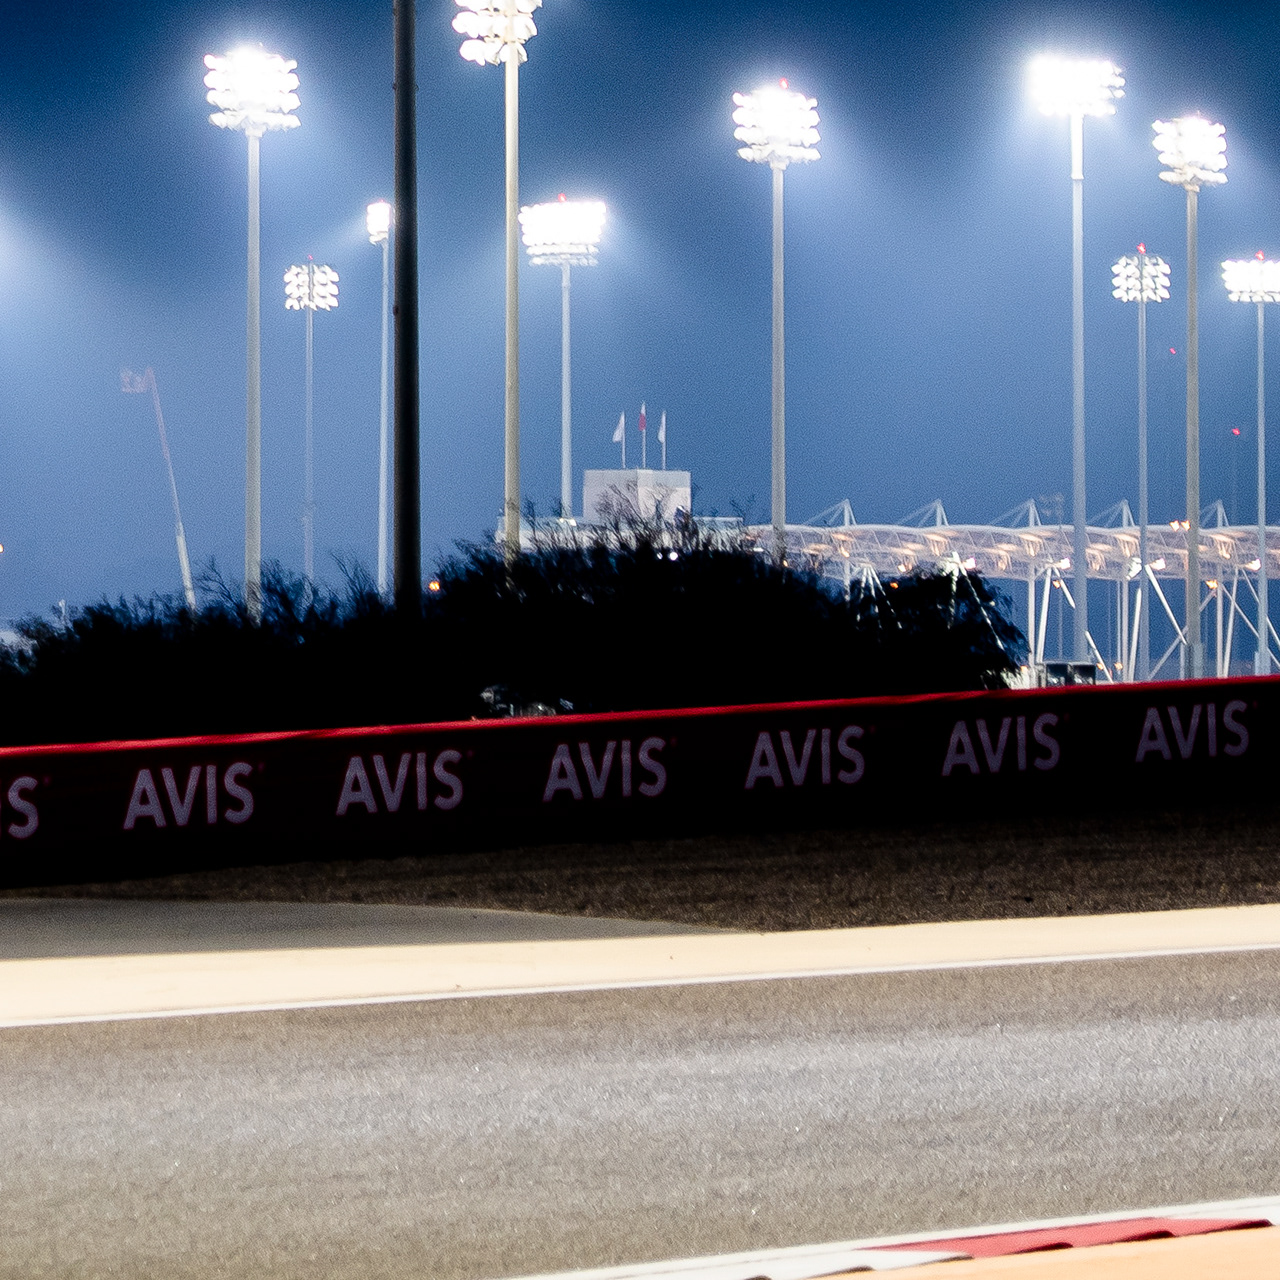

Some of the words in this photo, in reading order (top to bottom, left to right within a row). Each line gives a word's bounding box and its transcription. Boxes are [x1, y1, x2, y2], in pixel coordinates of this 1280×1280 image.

[745, 725, 865, 788] AVIS
[942, 712, 1061, 776] AVIS
[1136, 699, 1250, 762] AVIS
[124, 761, 254, 829] AVIS
[337, 749, 463, 815] AVIS
[544, 736, 667, 801] AVIS
